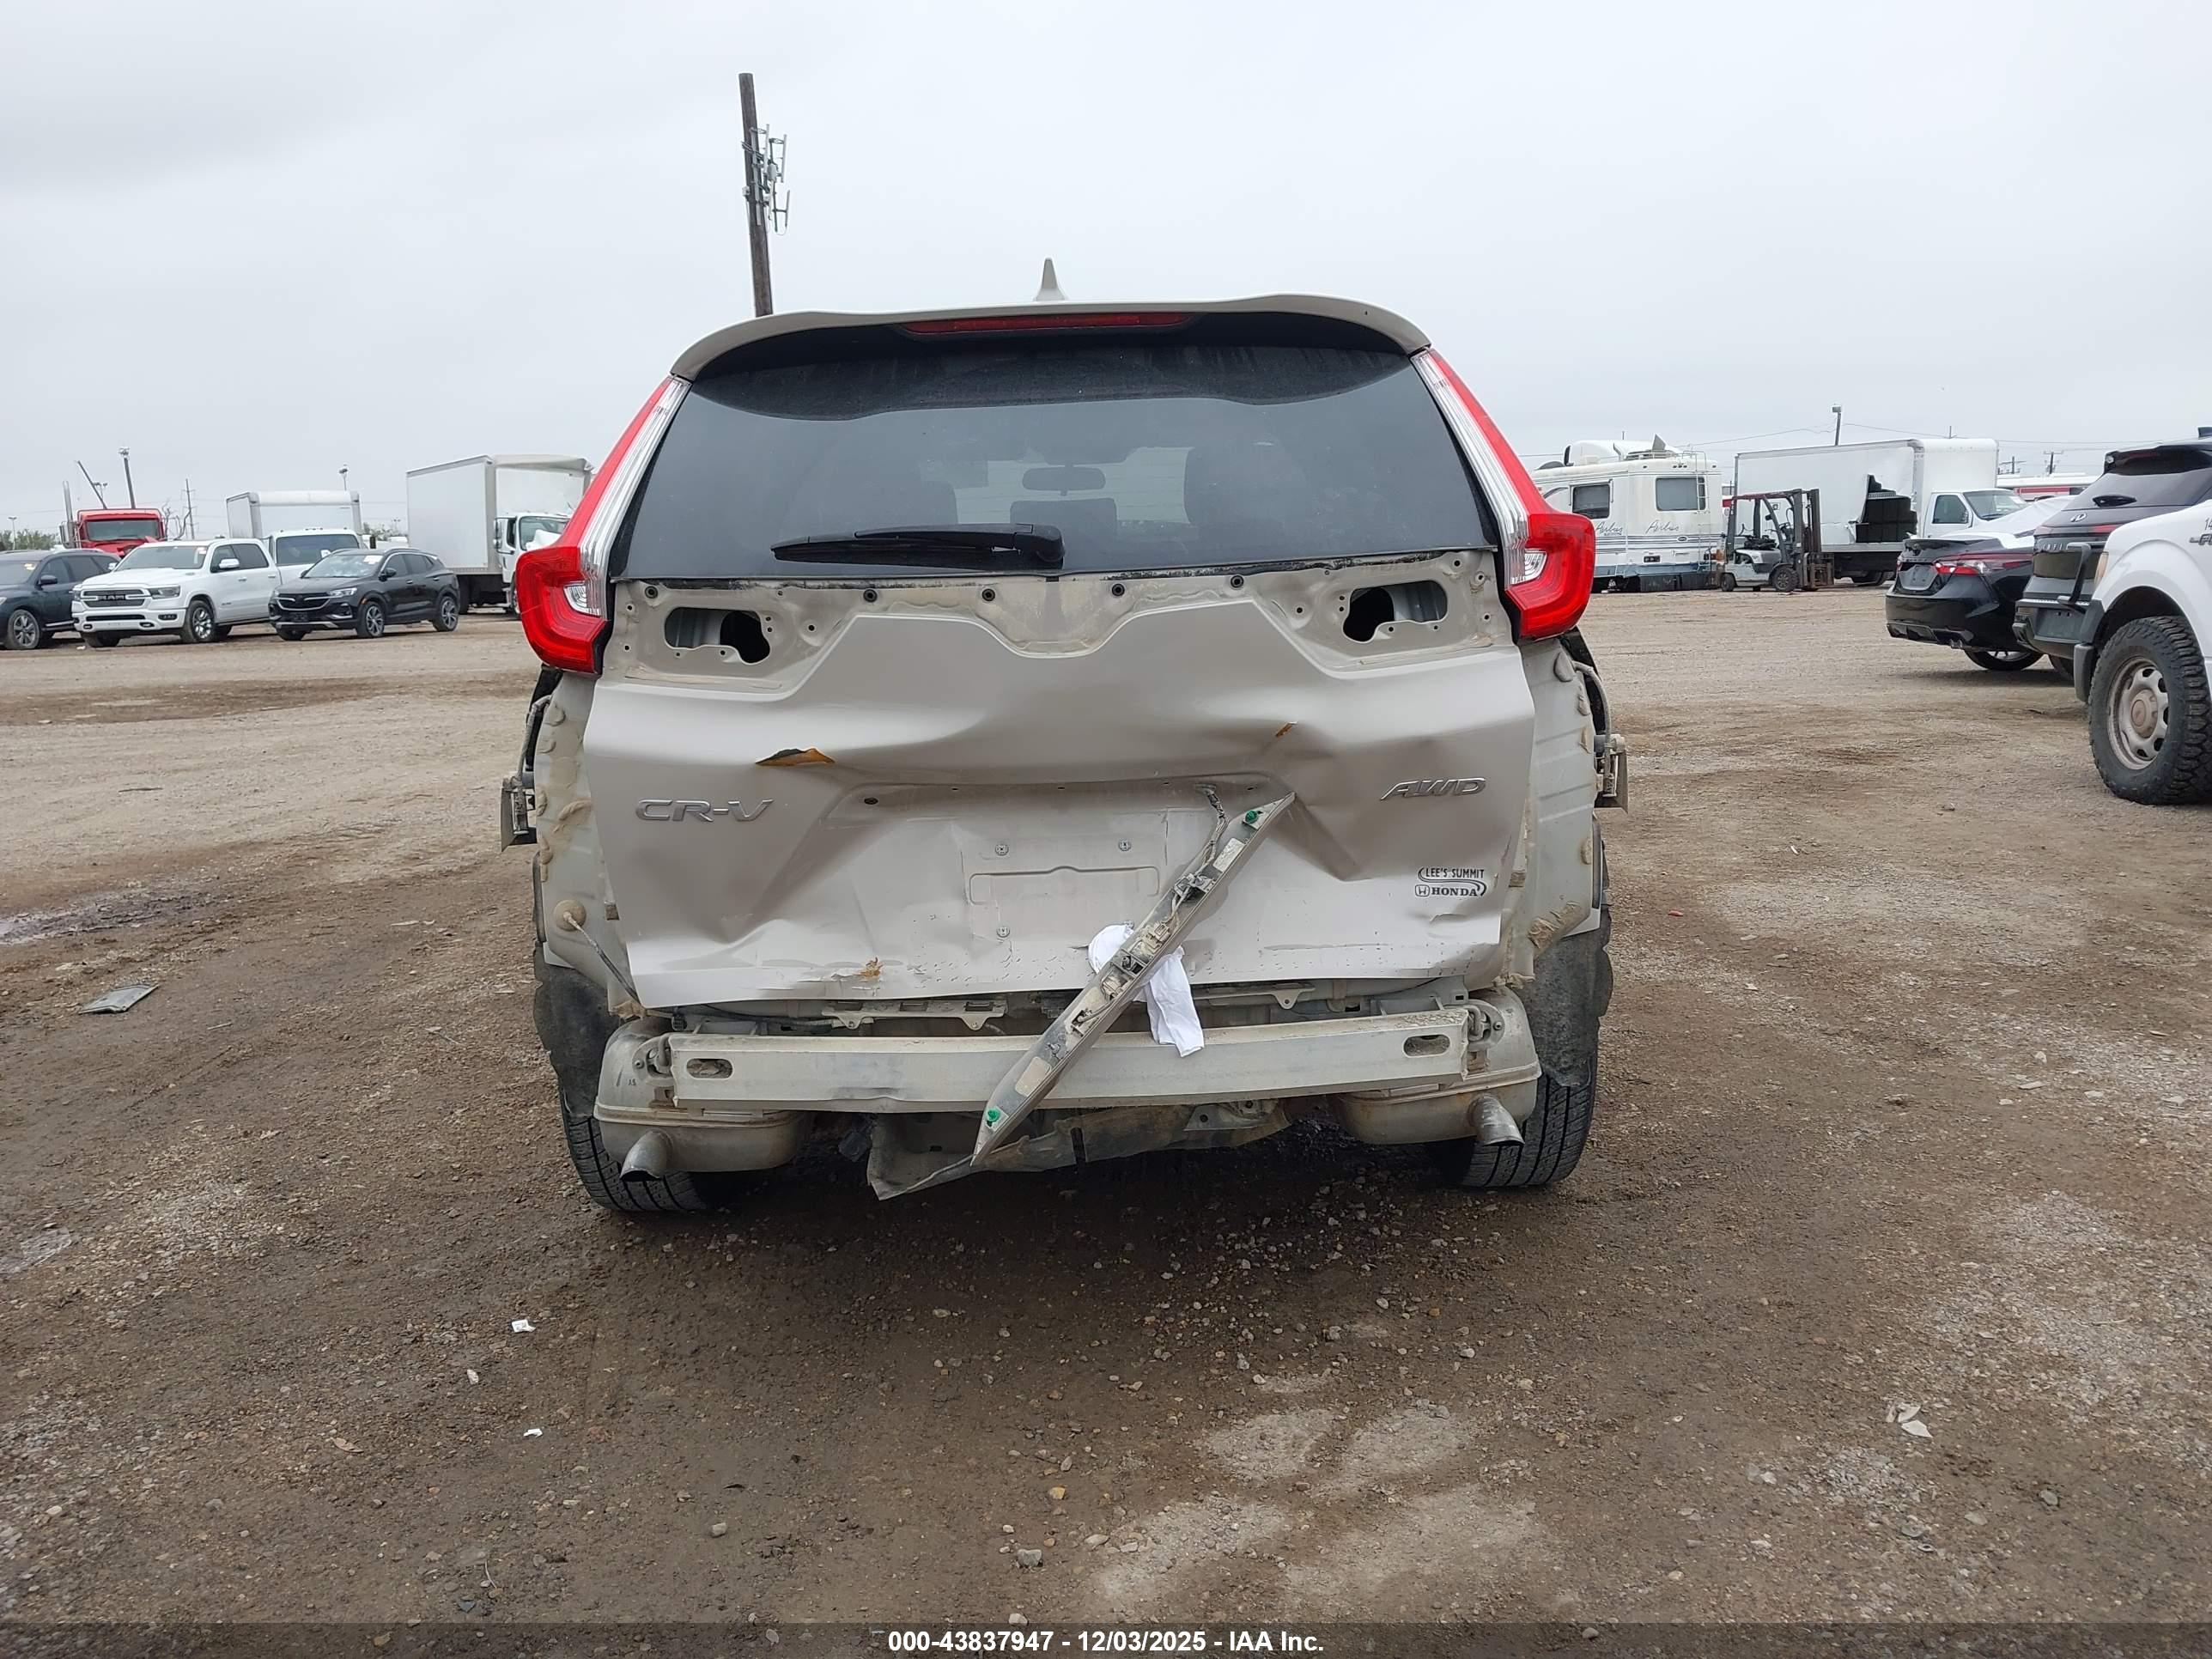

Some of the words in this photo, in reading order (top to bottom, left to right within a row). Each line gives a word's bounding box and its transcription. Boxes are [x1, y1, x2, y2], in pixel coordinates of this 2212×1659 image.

[1380, 777, 1486, 801] AWD
[636, 799, 775, 822] CR-V
[1425, 867, 1448, 878] LEE'S
[1451, 868, 1485, 878] SUMMIT
[1431, 887, 1478, 896] HONDA
